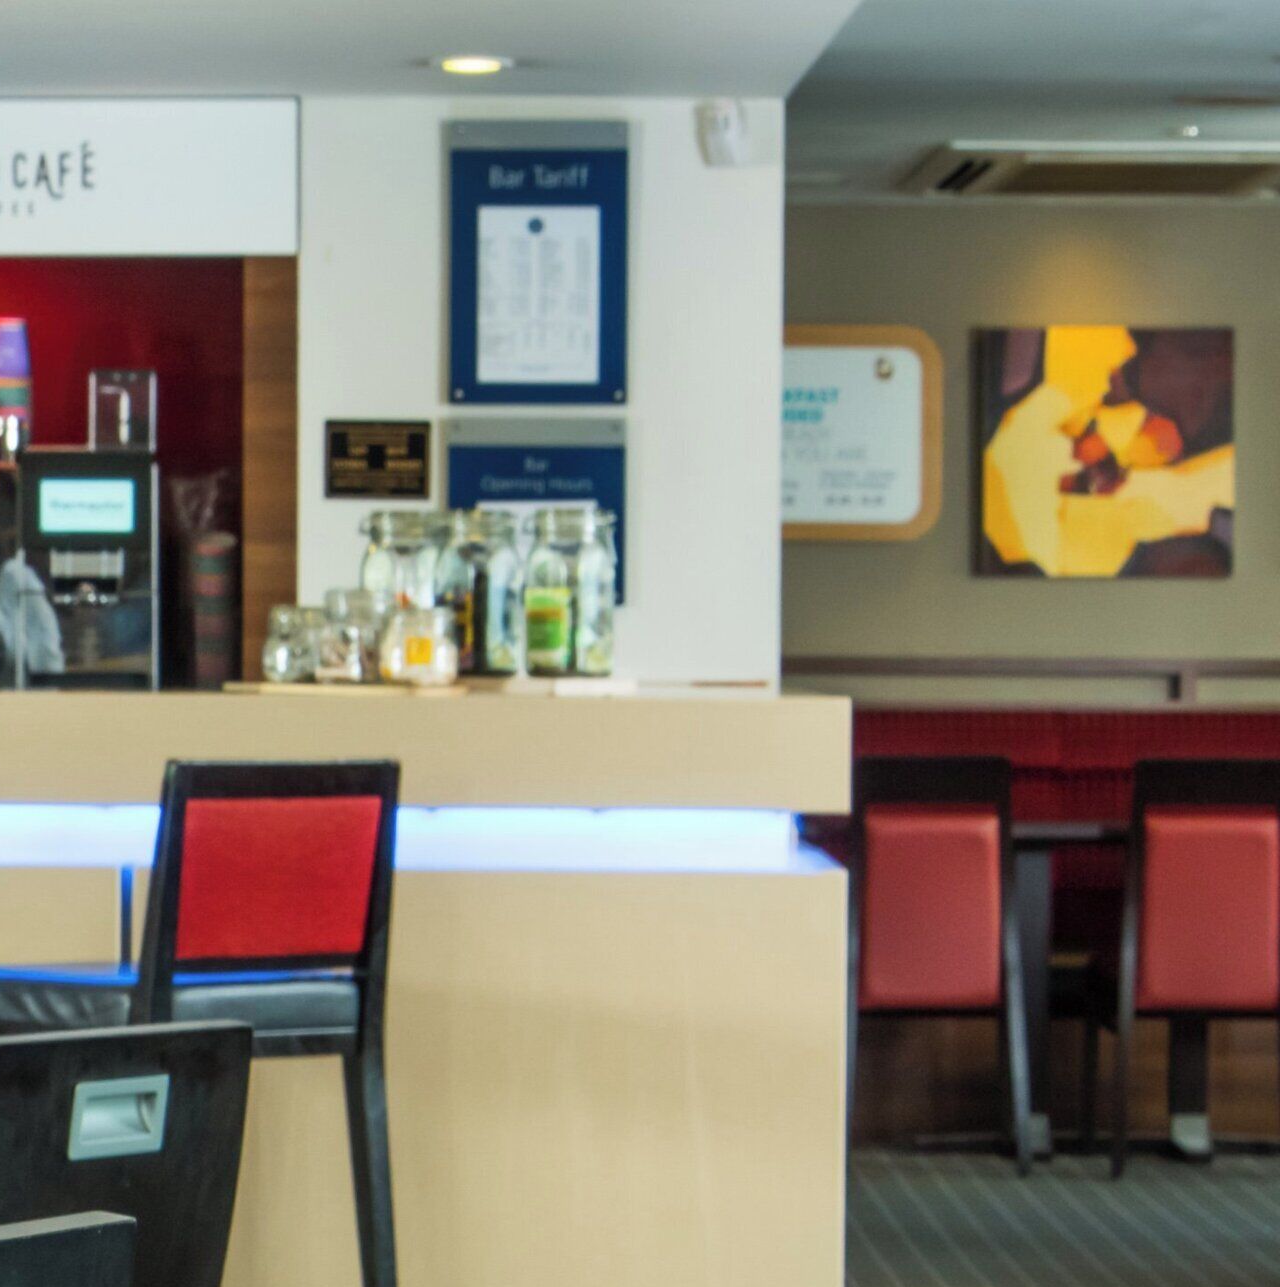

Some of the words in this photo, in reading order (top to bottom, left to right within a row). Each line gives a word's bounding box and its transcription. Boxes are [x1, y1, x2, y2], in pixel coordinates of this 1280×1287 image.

[11, 141, 96, 200] CAFÉ
[489, 165, 524, 189] Bar
[534, 163, 589, 189] Tariff
